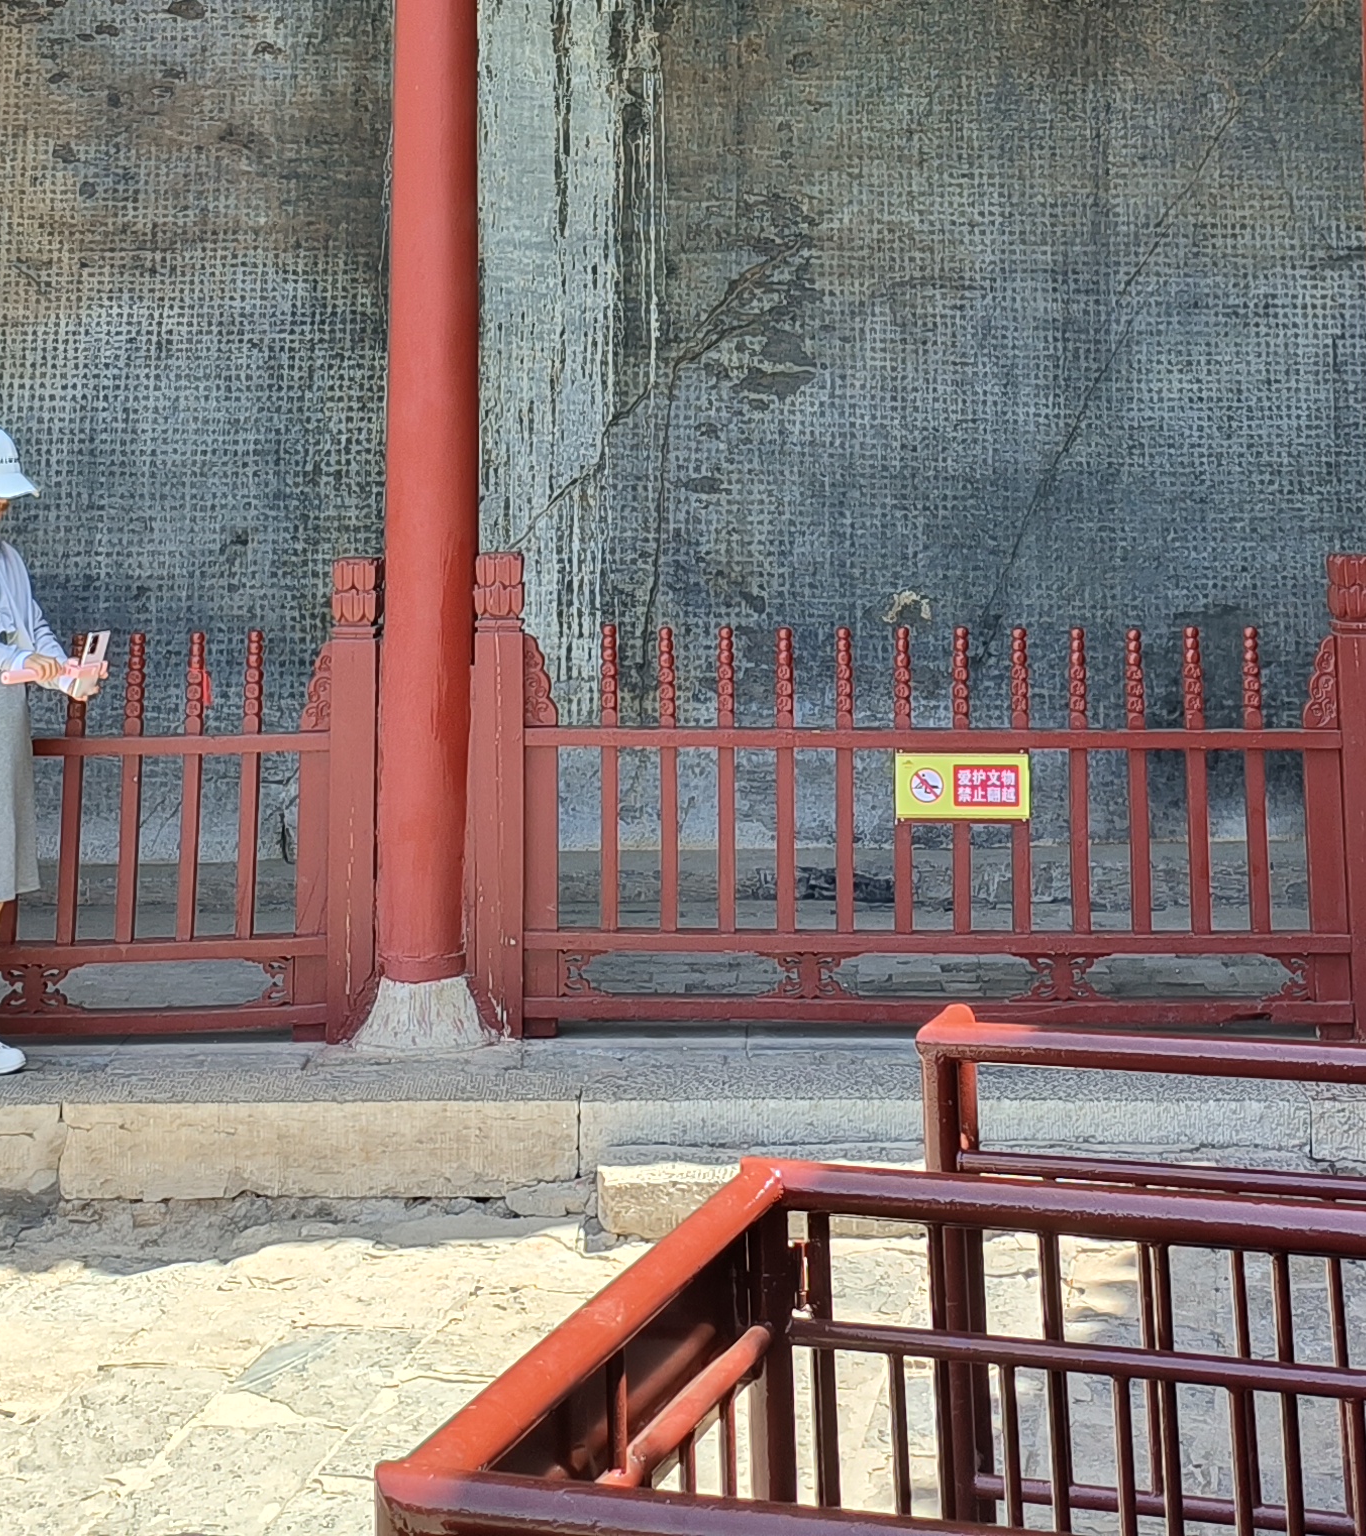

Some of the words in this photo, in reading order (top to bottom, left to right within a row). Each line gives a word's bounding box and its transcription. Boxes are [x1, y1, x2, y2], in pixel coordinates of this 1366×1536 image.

[957, 769, 1016, 786] 爱护文物
[957, 786, 1016, 803] 禁止翻越
